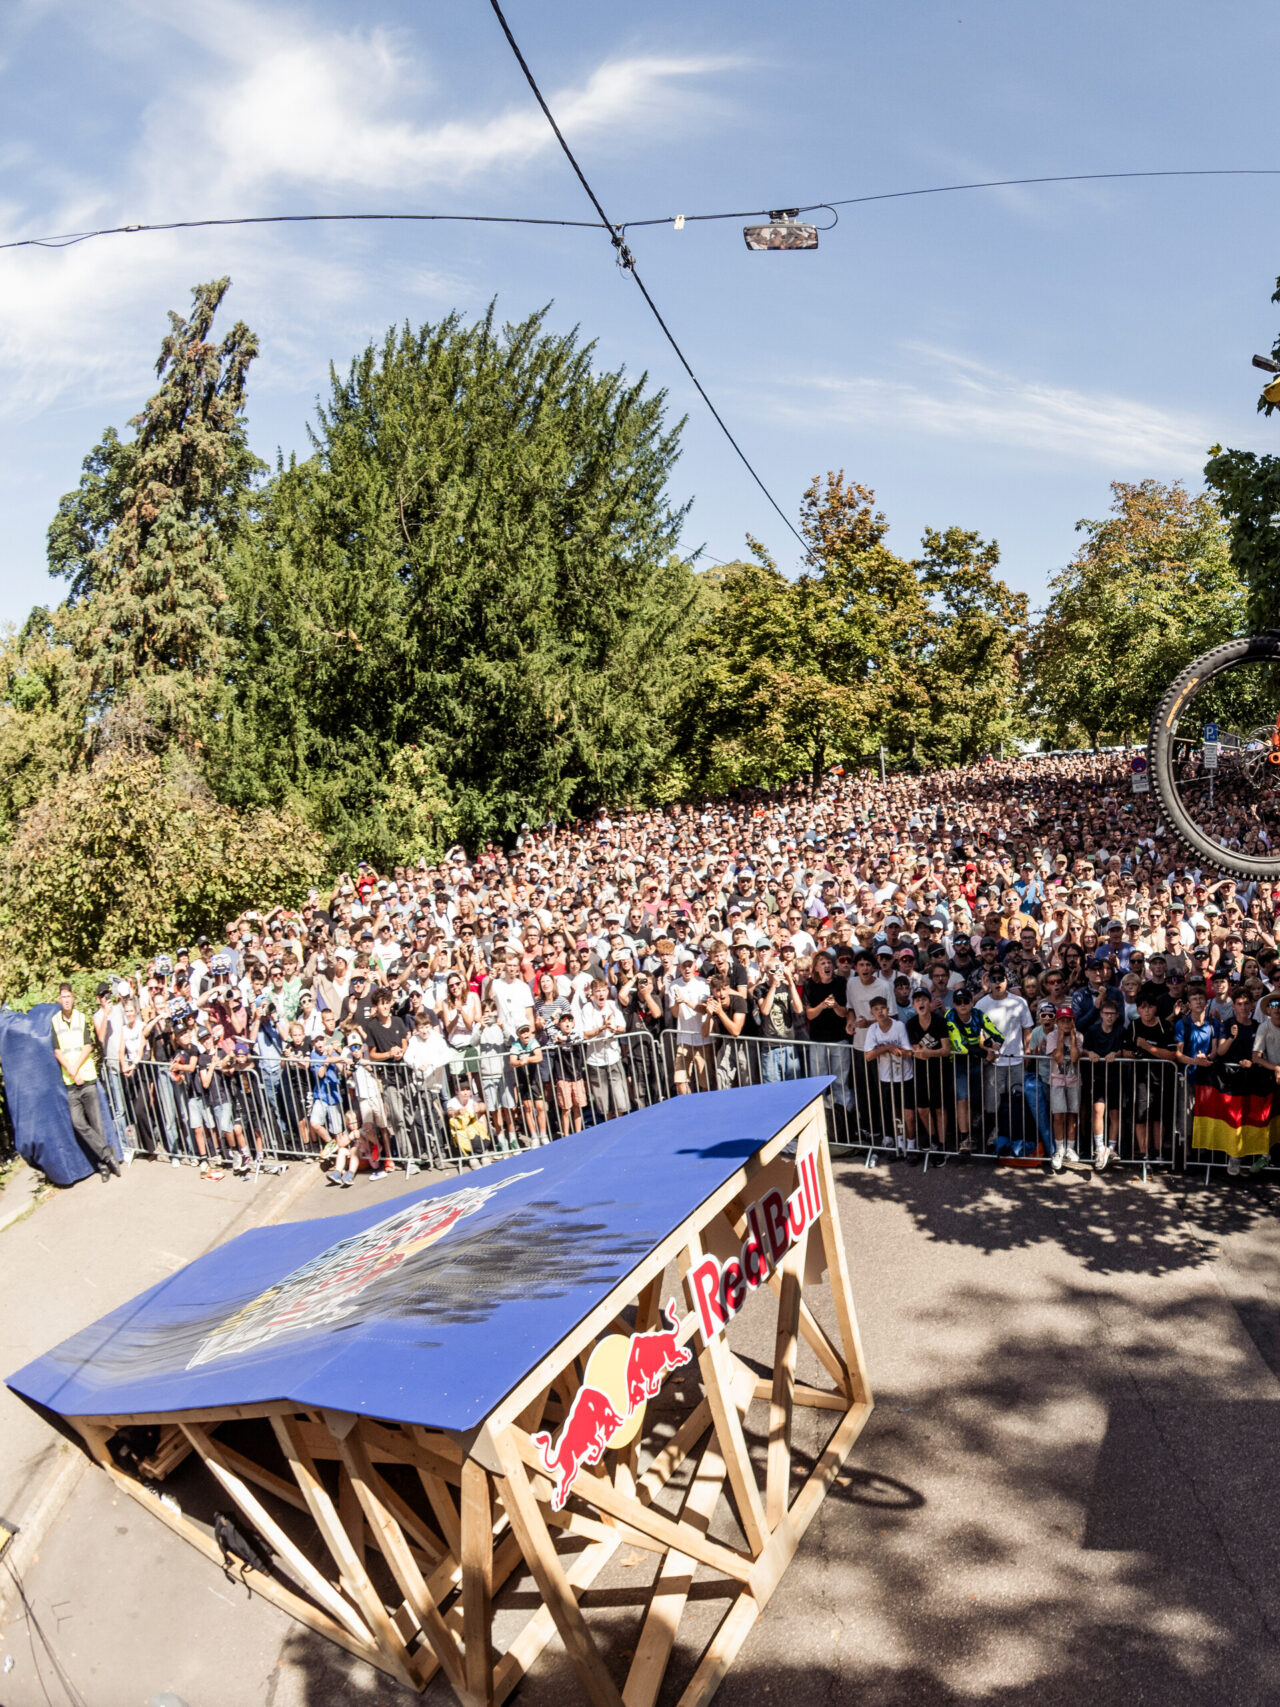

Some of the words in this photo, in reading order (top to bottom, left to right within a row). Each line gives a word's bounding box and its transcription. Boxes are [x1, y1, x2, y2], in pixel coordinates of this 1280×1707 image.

[1206, 726, 1214, 740] P
[691, 1204, 769, 1342] Red
[763, 1151, 822, 1265] Bull
